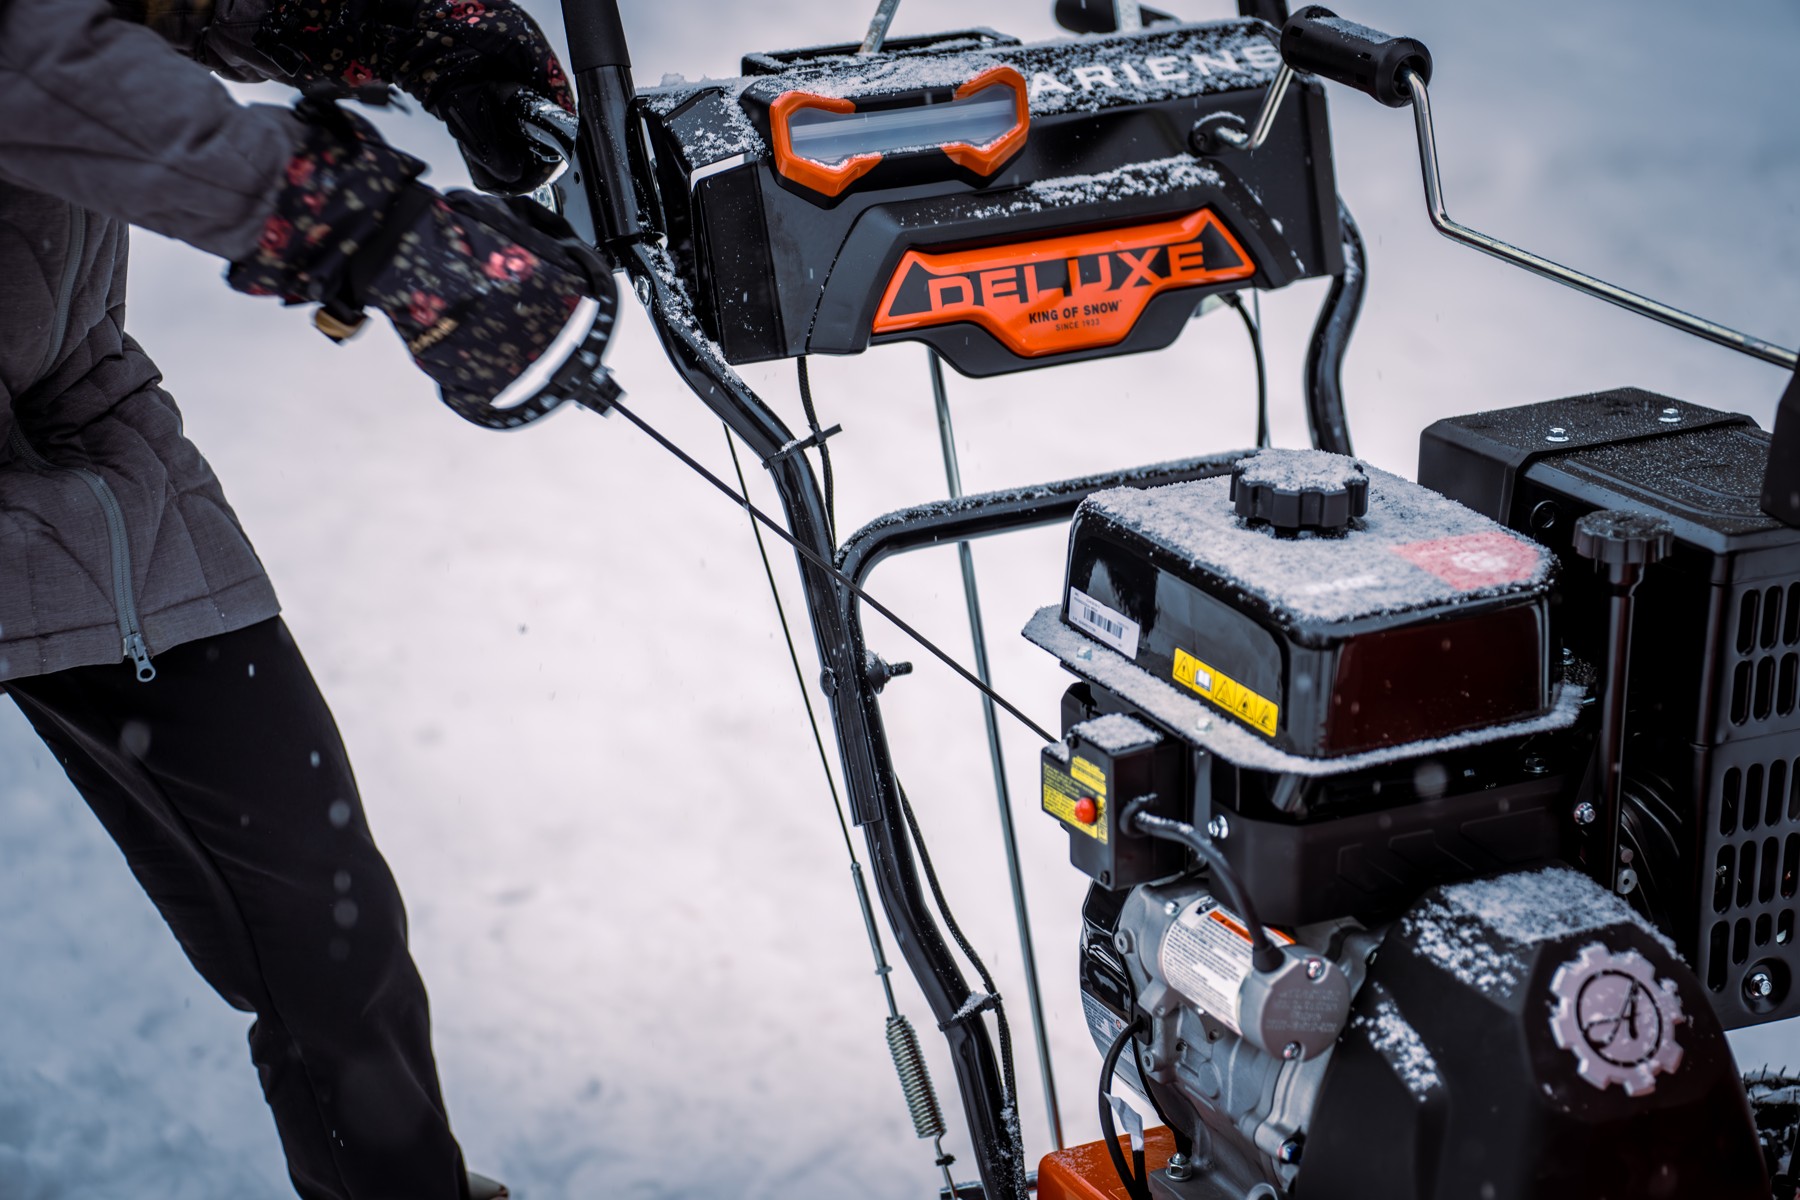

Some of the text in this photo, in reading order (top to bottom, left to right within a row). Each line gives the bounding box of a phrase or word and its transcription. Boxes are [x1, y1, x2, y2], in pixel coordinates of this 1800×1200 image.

[1029, 44, 1281, 98] ARIENS
[927, 242, 1206, 309] DELUXE
[1029, 302, 1119, 324] KING OF SNOW
[1055, 318, 1100, 332] SINCE 1933
